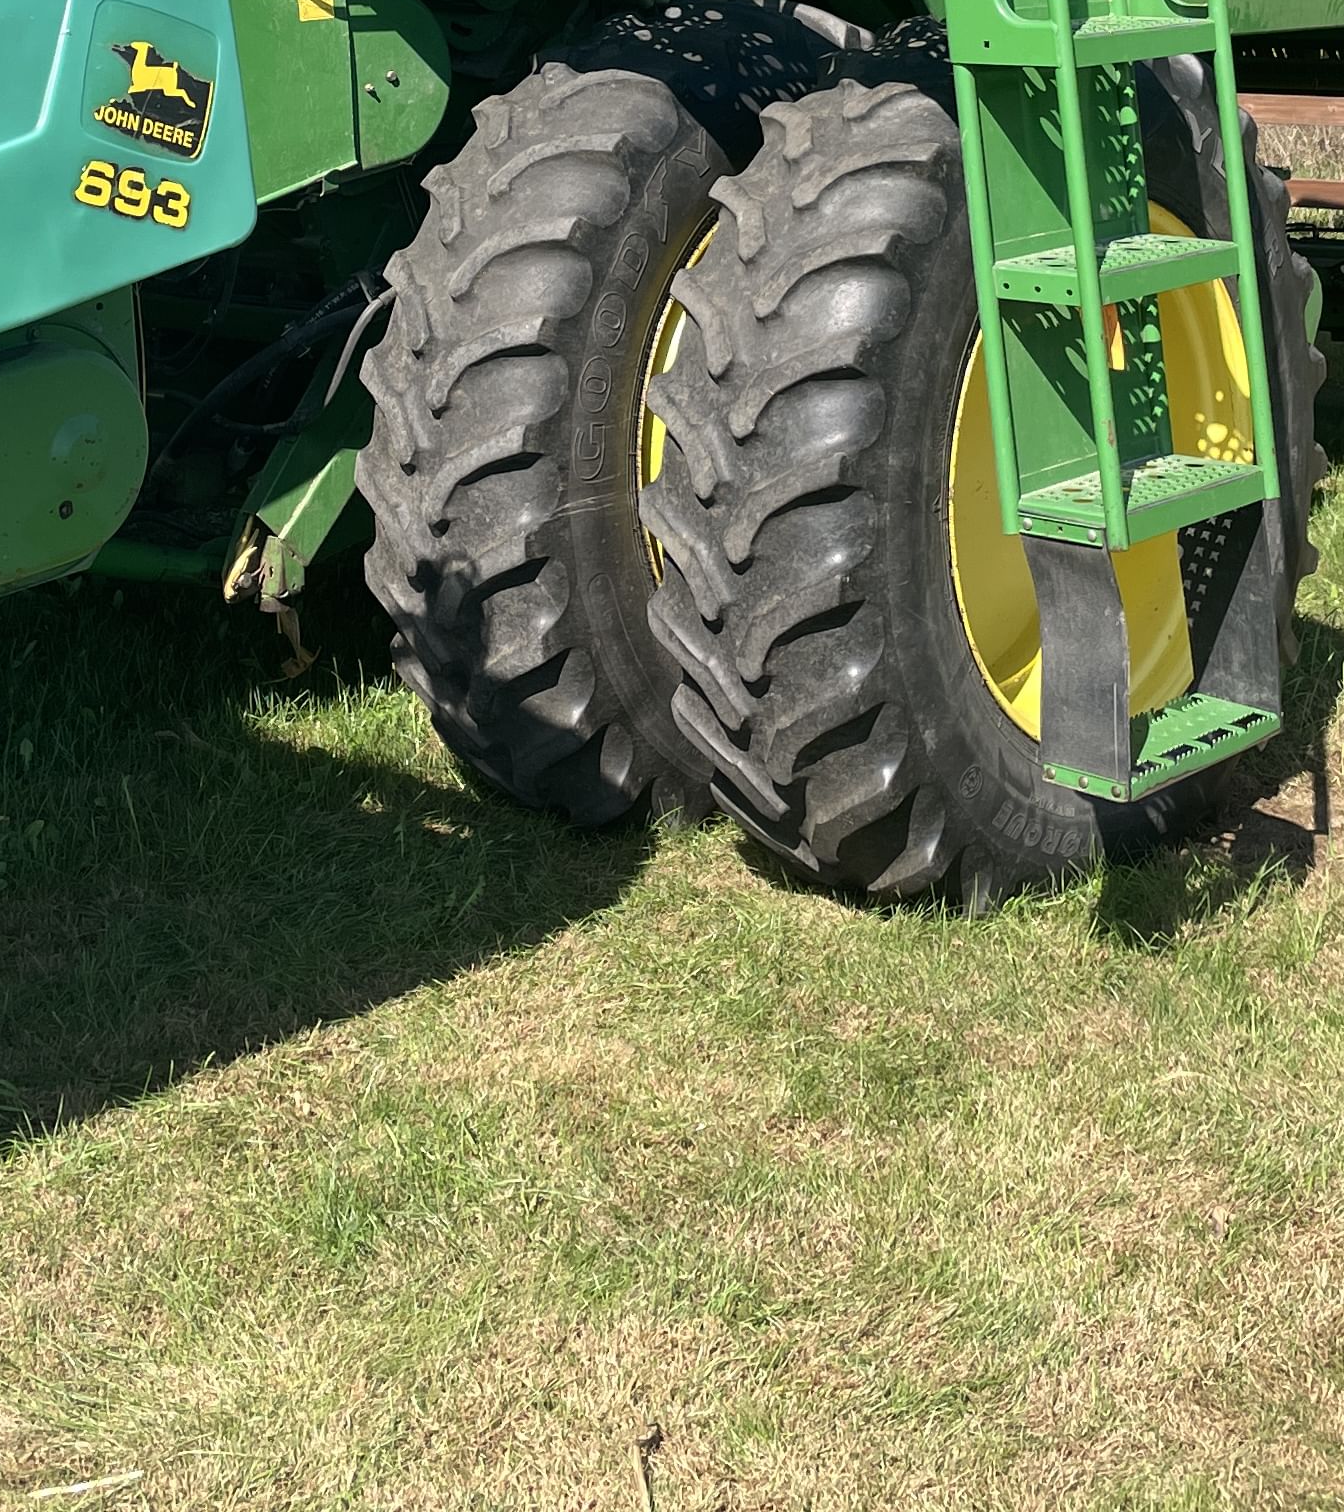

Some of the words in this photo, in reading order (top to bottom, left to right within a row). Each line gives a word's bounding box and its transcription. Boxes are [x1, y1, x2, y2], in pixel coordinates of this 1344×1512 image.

[93, 104, 141, 133] JOHN
[141, 118, 195, 149] DEERE
[73, 160, 192, 229] 693
